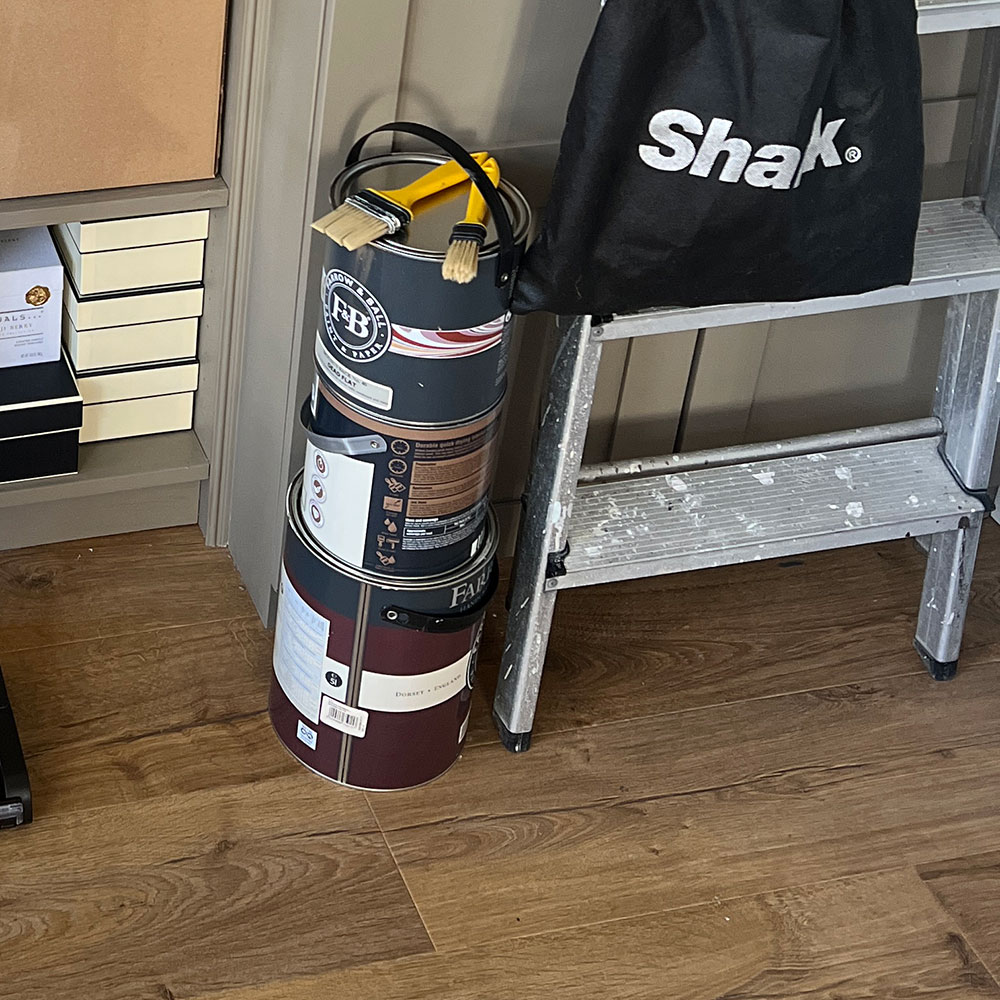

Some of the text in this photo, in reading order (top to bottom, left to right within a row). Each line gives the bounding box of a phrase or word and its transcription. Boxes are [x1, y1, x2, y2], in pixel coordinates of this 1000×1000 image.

[638, 107, 846, 190] Shak
[331, 291, 371, 338] F&B
[365, 297, 387, 329] BALL
[351, 343, 384, 359] PAPER
[341, 375, 357, 388] FLAT
